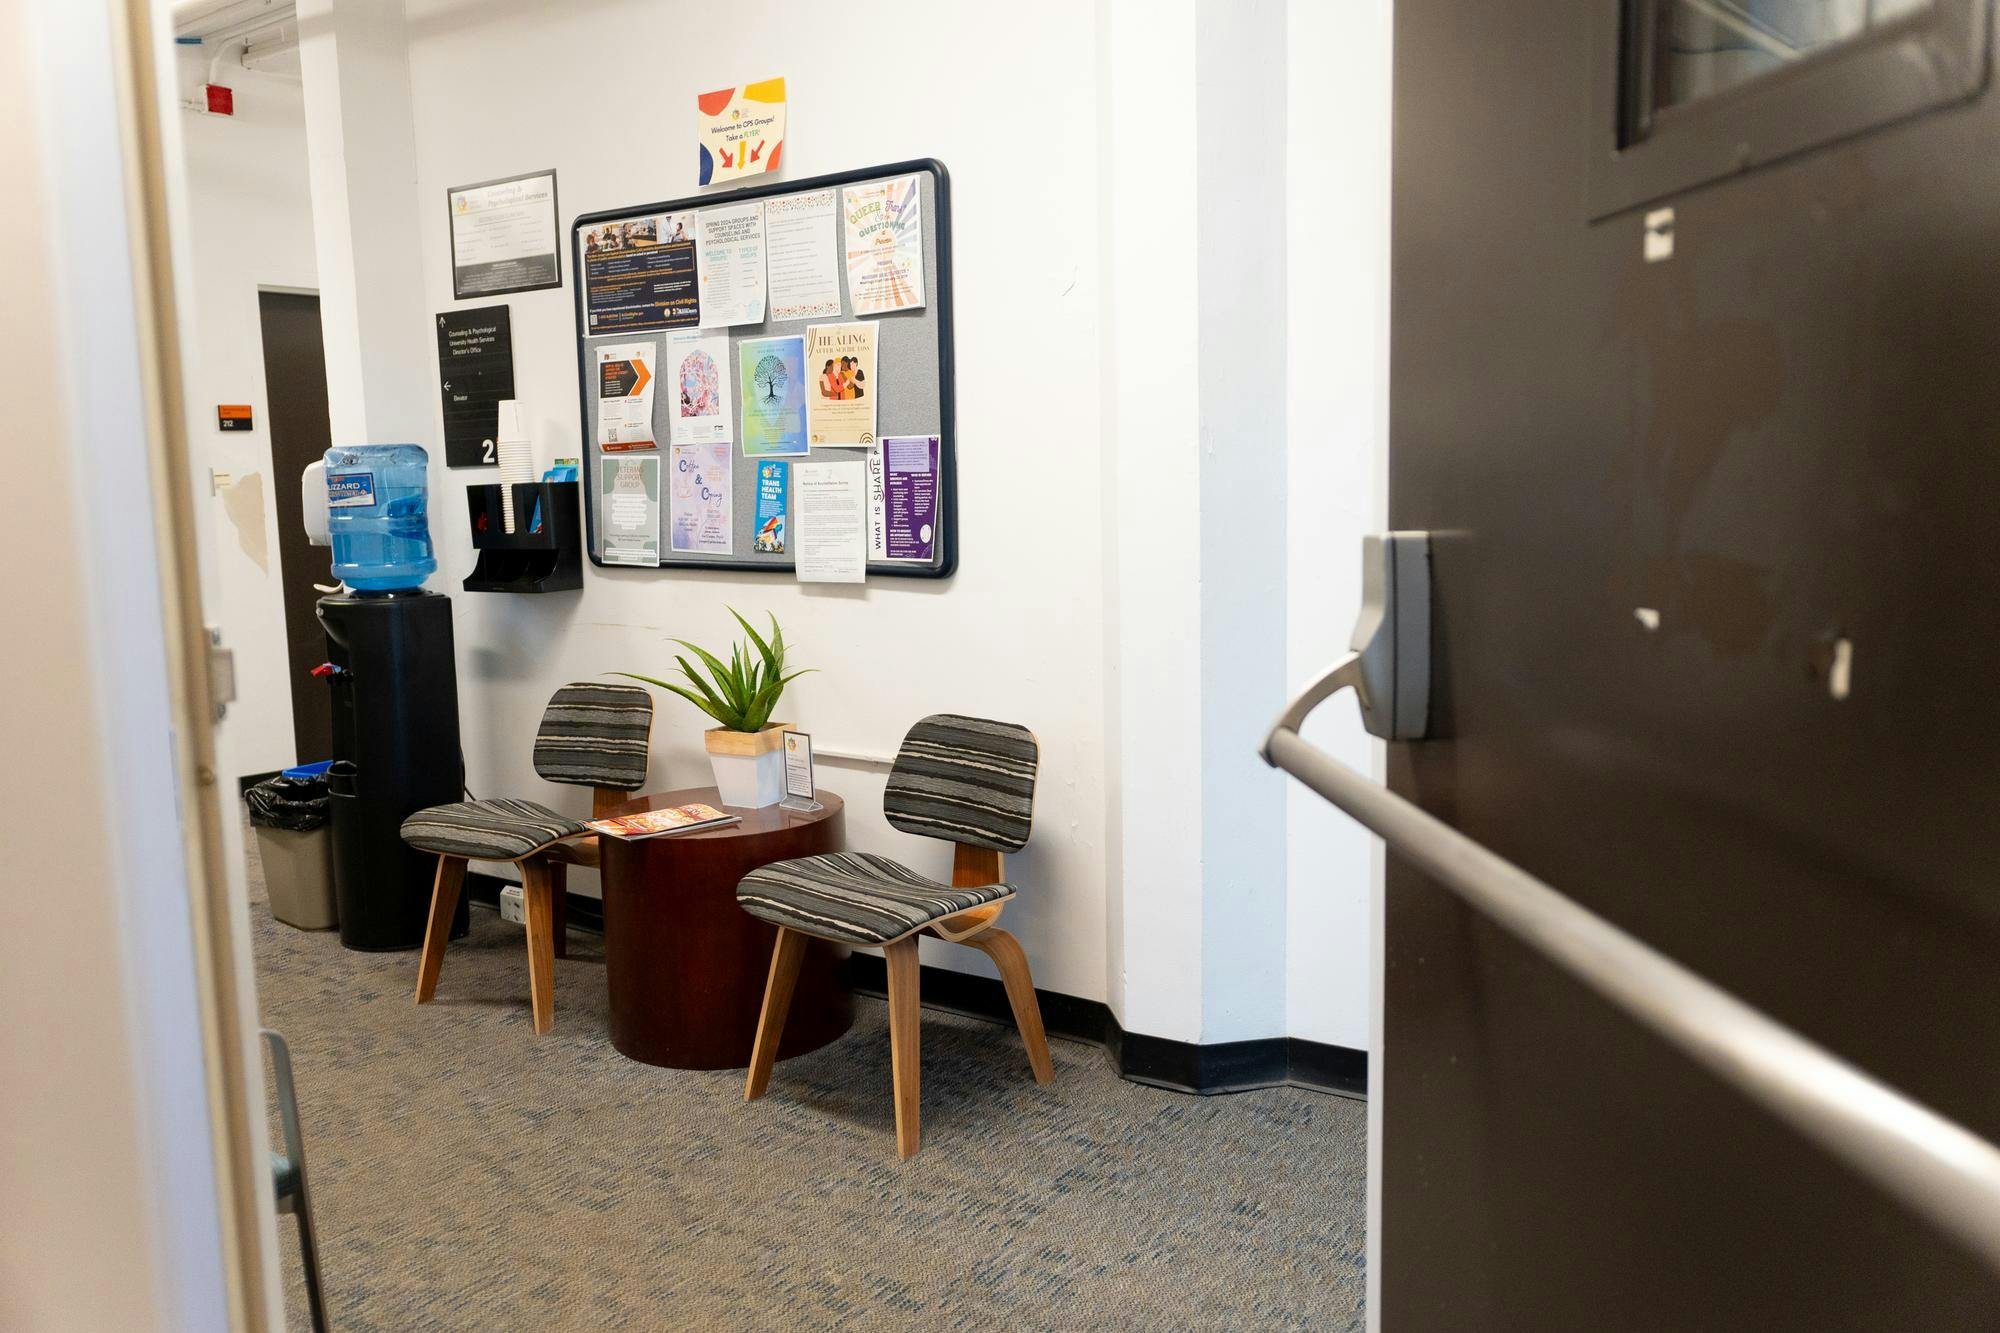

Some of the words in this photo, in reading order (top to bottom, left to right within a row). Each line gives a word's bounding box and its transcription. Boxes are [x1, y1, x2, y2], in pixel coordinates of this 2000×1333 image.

[711, 124, 736, 134] Welcome
[743, 120, 754, 128] CPS
[754, 115, 775, 127] Groups!
[726, 133, 739, 142] Take
[743, 129, 760, 138] FLYER!
[849, 200, 881, 225] QUEER
[705, 221, 720, 229] SPRING
[720, 219, 731, 227] 2024
[731, 217, 749, 225] GROUPS
[750, 215, 759, 223] AND
[708, 226, 727, 234] SUPPORT
[744, 221, 757, 229] WITH
[705, 236, 739, 246] PSYCHOLOGICAL
[739, 233, 761, 242] SERVICES
[713, 231, 740, 239] COUNSELING
[449, 330, 469, 338] Counseling
[473, 326, 497, 336] Psychological
[449, 338, 467, 348] University
[467, 337, 479, 346] Health
[479, 335, 495, 344] Services
[818, 334, 866, 347] HEALING
[470, 347, 482, 355] Office
[482, 439, 495, 464] 2
[679, 459, 700, 473] Coffee
[617, 473, 642, 481] SUPPORT
[695, 474, 703, 485] &
[762, 479, 780, 487] TRANS
[327, 482, 360, 491] LIZZARD
[620, 481, 641, 489] GROUP
[761, 486, 782, 495] HEALTH
[761, 493, 777, 501] TEAM
[875, 506, 882, 515] IS
[873, 521, 884, 550] WHAT
